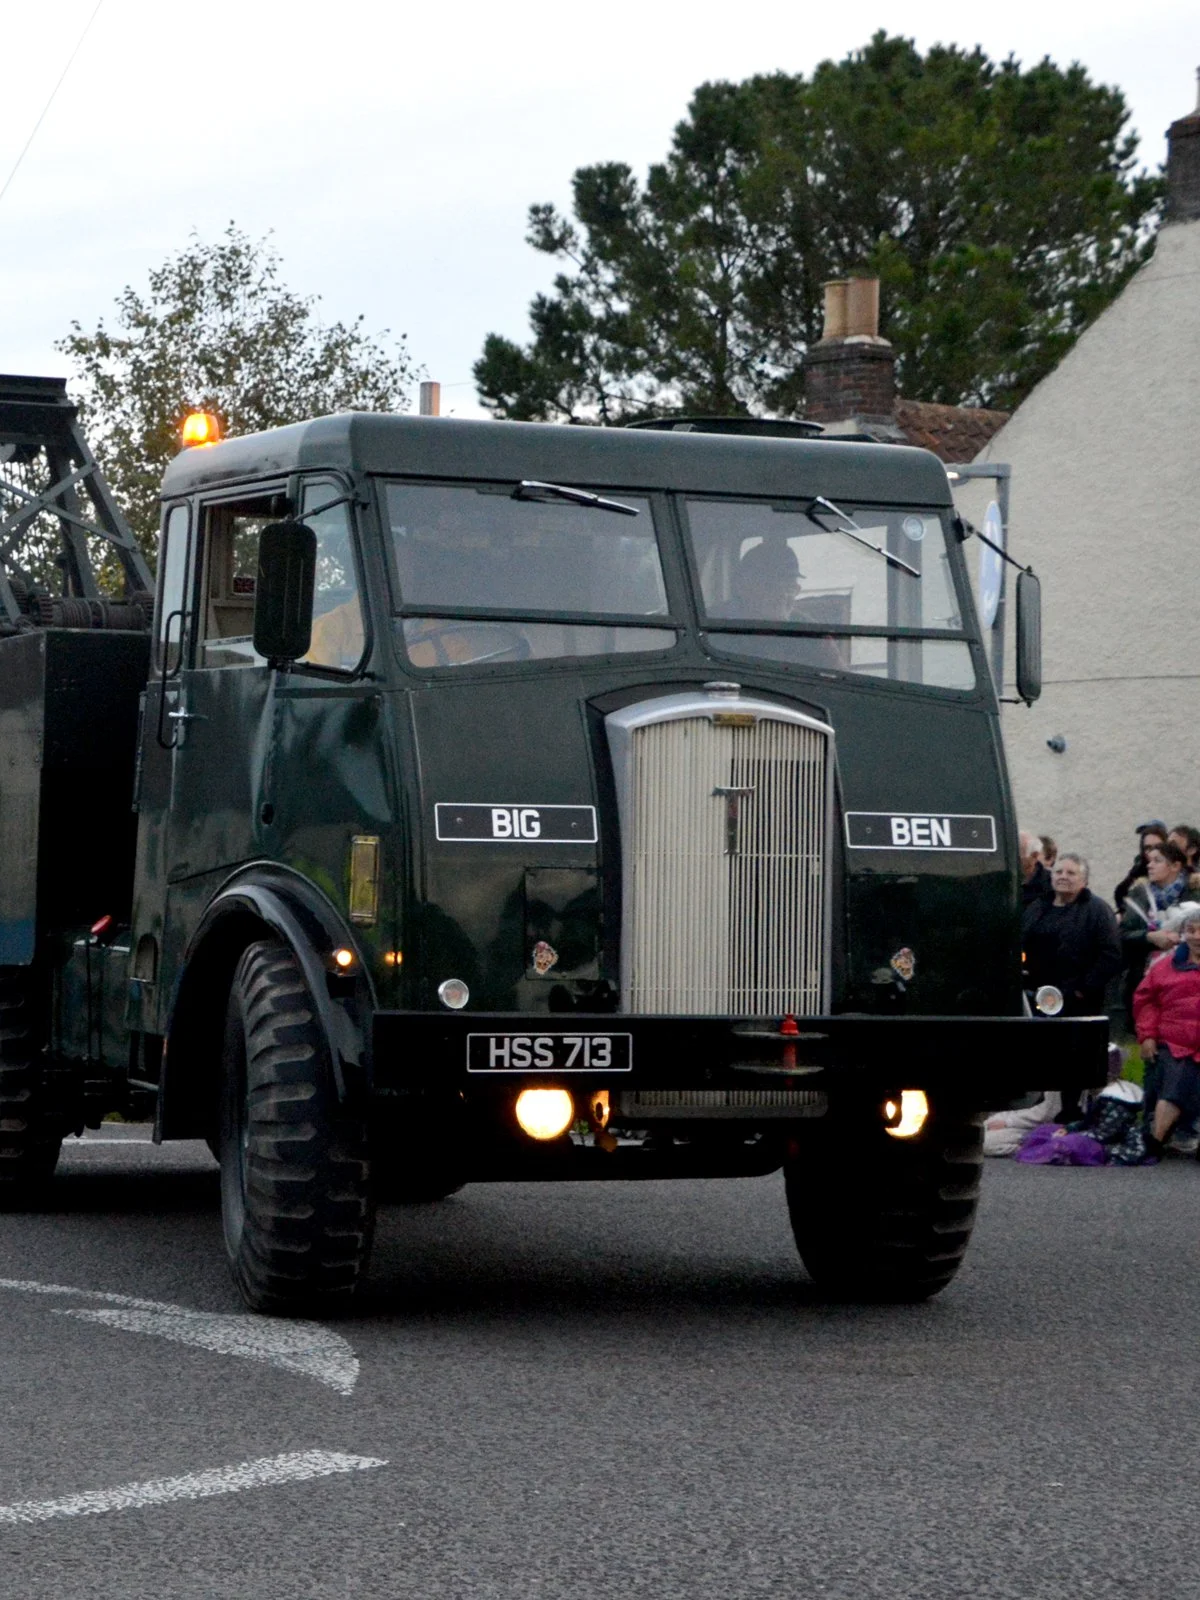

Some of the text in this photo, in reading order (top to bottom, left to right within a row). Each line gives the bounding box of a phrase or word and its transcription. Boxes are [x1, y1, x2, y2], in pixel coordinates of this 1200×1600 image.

[491, 808, 541, 838] BIG
[890, 817, 952, 846] BEN
[489, 1037, 612, 1068] HSS 713
